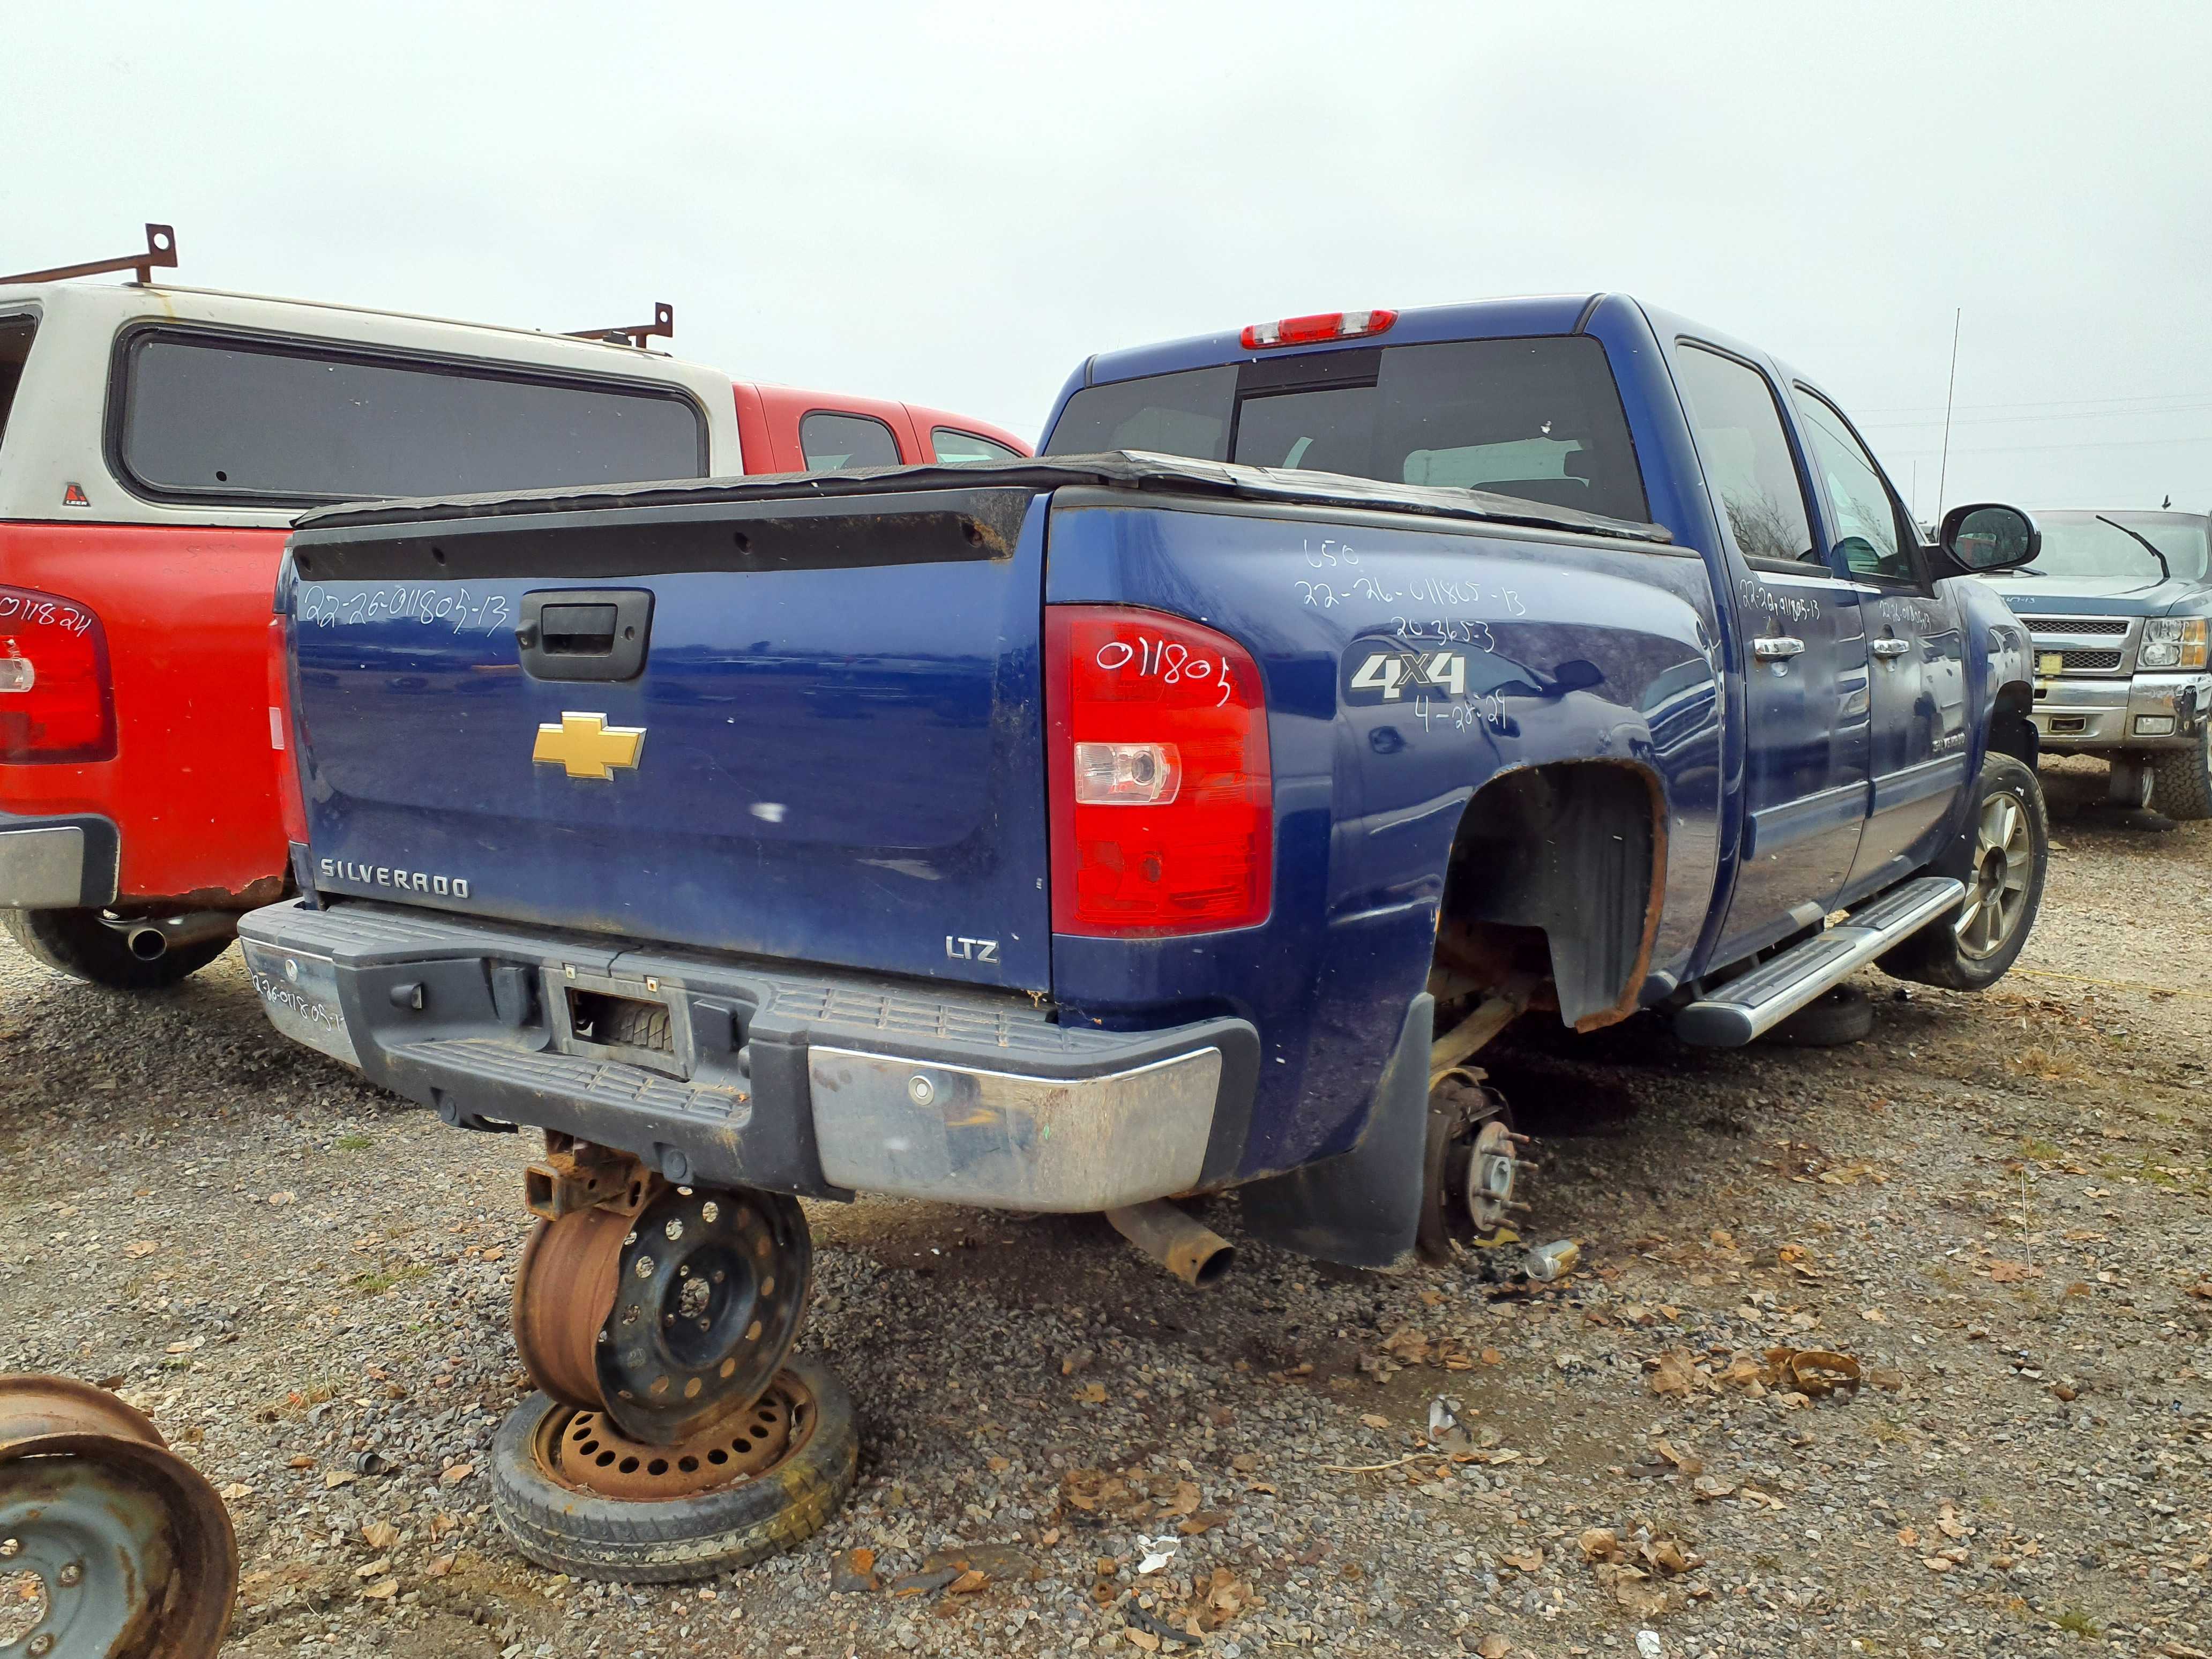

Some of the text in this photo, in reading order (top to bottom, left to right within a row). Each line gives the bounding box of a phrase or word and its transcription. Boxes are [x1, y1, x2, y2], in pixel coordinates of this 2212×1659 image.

[0, 597, 92, 638] 011824
[305, 585, 510, 638] 22-26-011805-13
[1096, 637, 1231, 708] 011805
[320, 858, 469, 899] SILVERADO
[946, 936, 1000, 964] LTZ
